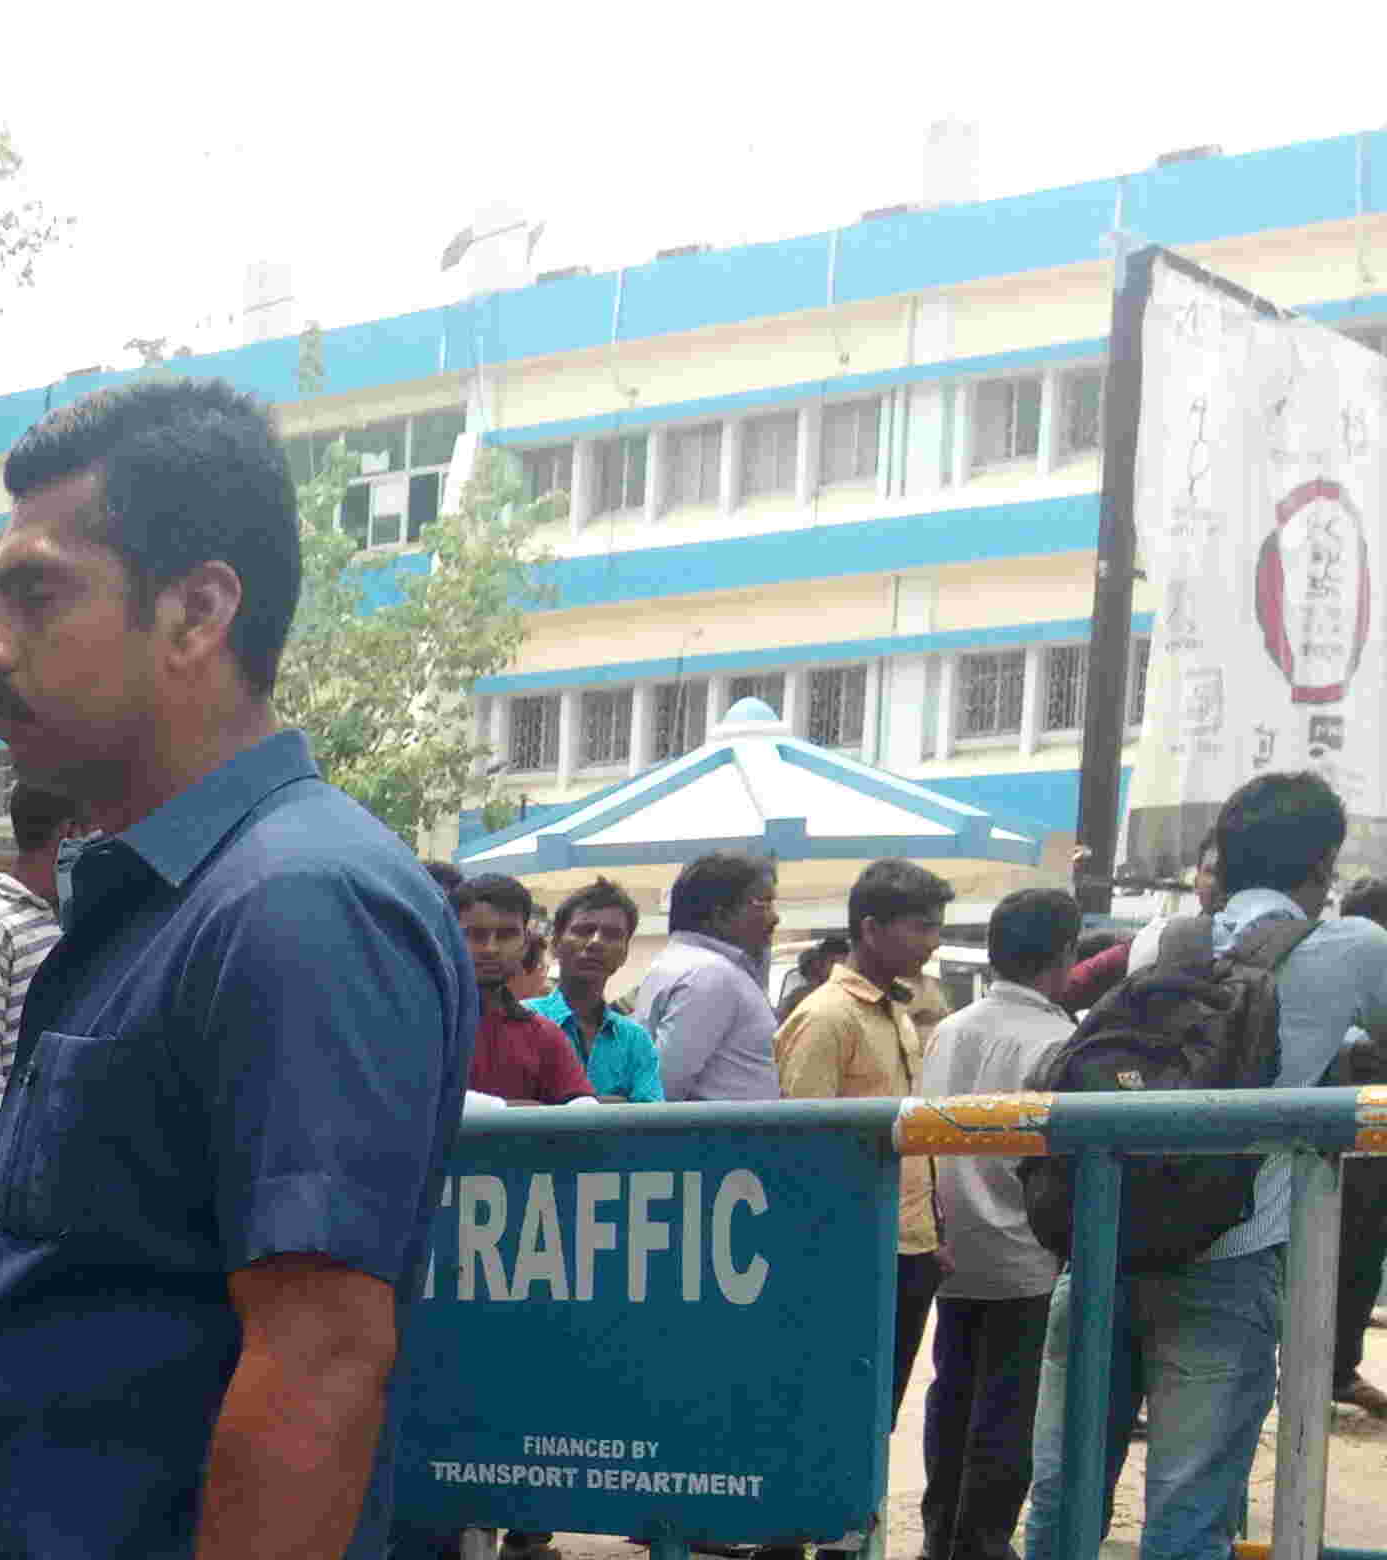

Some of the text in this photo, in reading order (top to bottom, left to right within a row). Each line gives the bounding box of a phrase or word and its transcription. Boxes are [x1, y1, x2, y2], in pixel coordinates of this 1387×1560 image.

[523, 1435, 660, 1460] FINANCED BY
[430, 1460, 764, 1498] TRANSPORT DEPARTMENT
